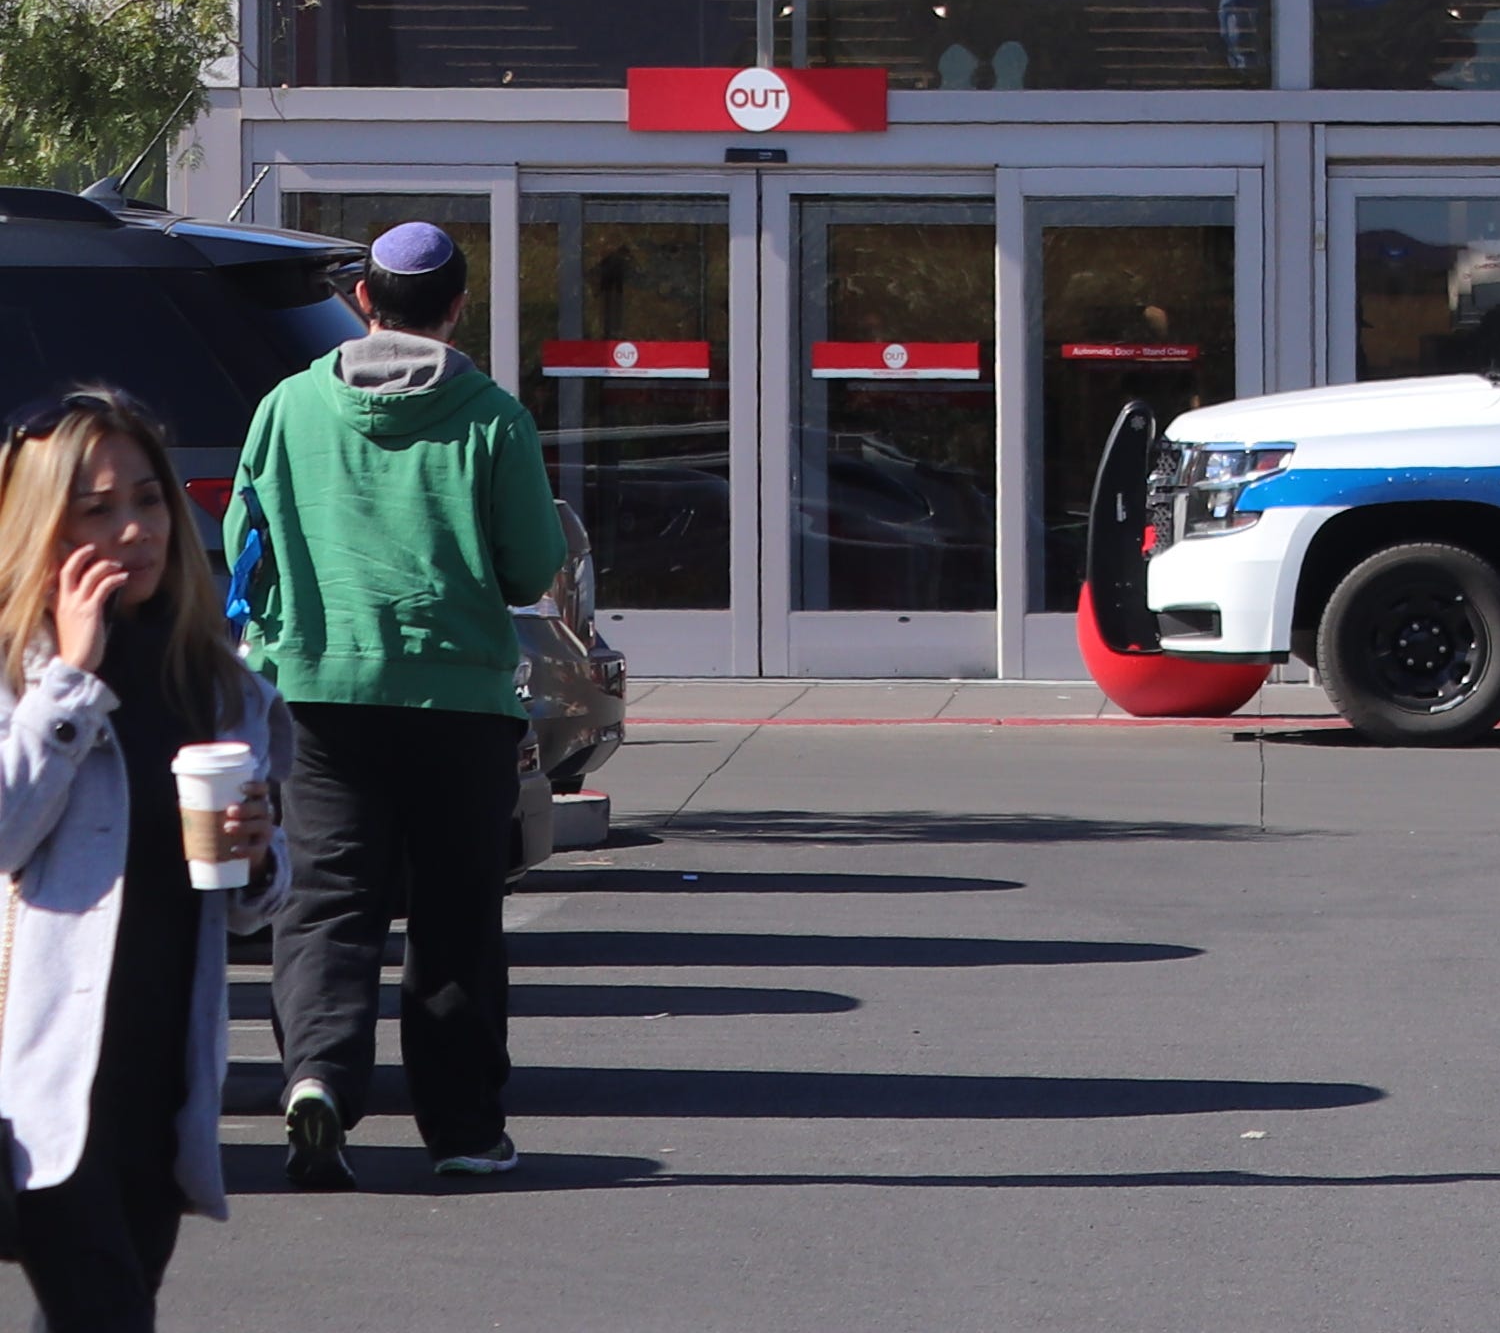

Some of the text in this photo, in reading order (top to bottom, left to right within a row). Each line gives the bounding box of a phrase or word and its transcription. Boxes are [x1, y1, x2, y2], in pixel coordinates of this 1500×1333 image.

[730, 88, 785, 109] OUT
[615, 351, 636, 360] OUT
[1072, 347, 1113, 356] Automatic
[1115, 348, 1135, 356] Door
[885, 352, 905, 361] OUT
